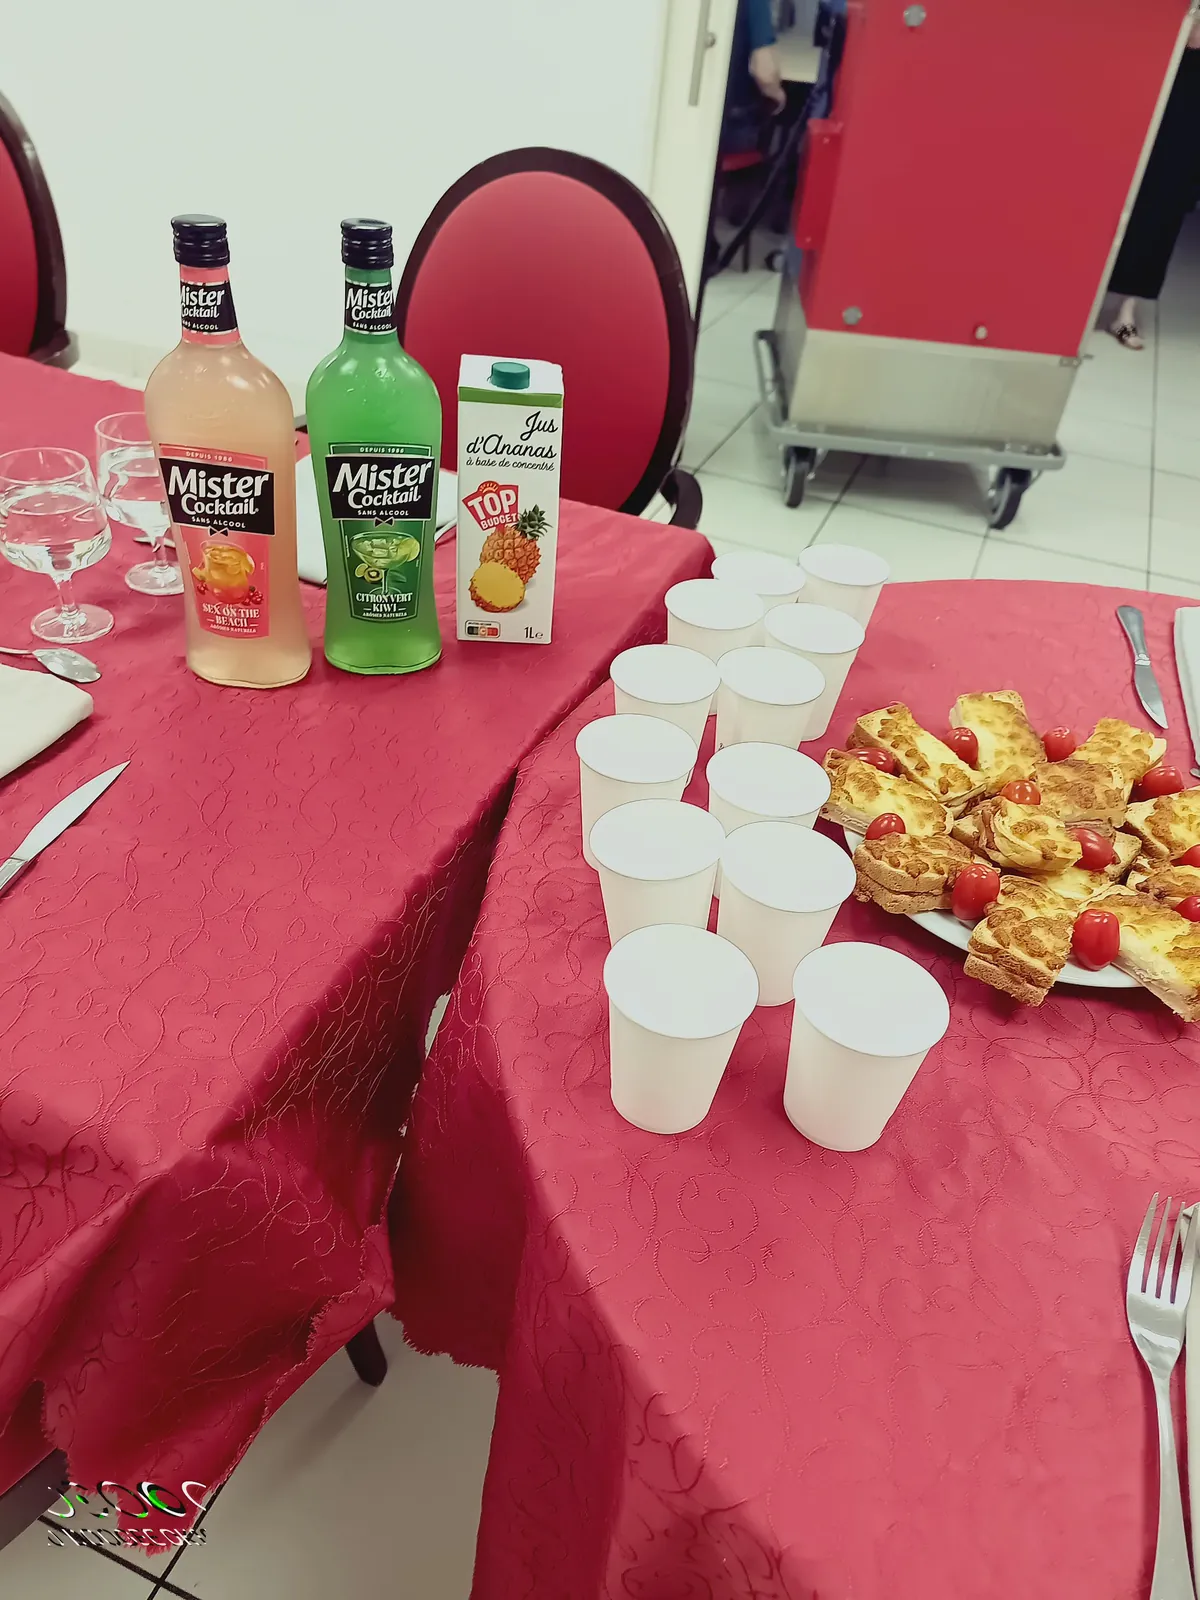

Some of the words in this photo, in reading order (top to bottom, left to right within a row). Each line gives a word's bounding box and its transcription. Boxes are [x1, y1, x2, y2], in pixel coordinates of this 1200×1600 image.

[192, 322, 219, 330] ALCOOL
[519, 410, 559, 441] Jus
[466, 433, 557, 459] d'Ananas
[185, 450, 212, 460] DEPUIS
[465, 456, 474, 466] à
[475, 456, 497, 467] base
[498, 457, 511, 468] de
[511, 461, 555, 472] concentré
[168, 465, 270, 499] Mister
[332, 460, 433, 493] Mister
[181, 493, 259, 516] Cocktail
[347, 485, 422, 510] Cocktail
[467, 489, 517, 521] TOP
[191, 516, 211, 524] SANS
[212, 519, 246, 529] ALCOOL
[480, 512, 518, 530] BUDGET
[390, 592, 413, 603] VERT
[202, 602, 221, 617] SEX
[222, 604, 237, 617] ON
[238, 608, 260, 619] THE
[372, 603, 397, 613] KIWI
[215, 614, 248, 628] BEACH
